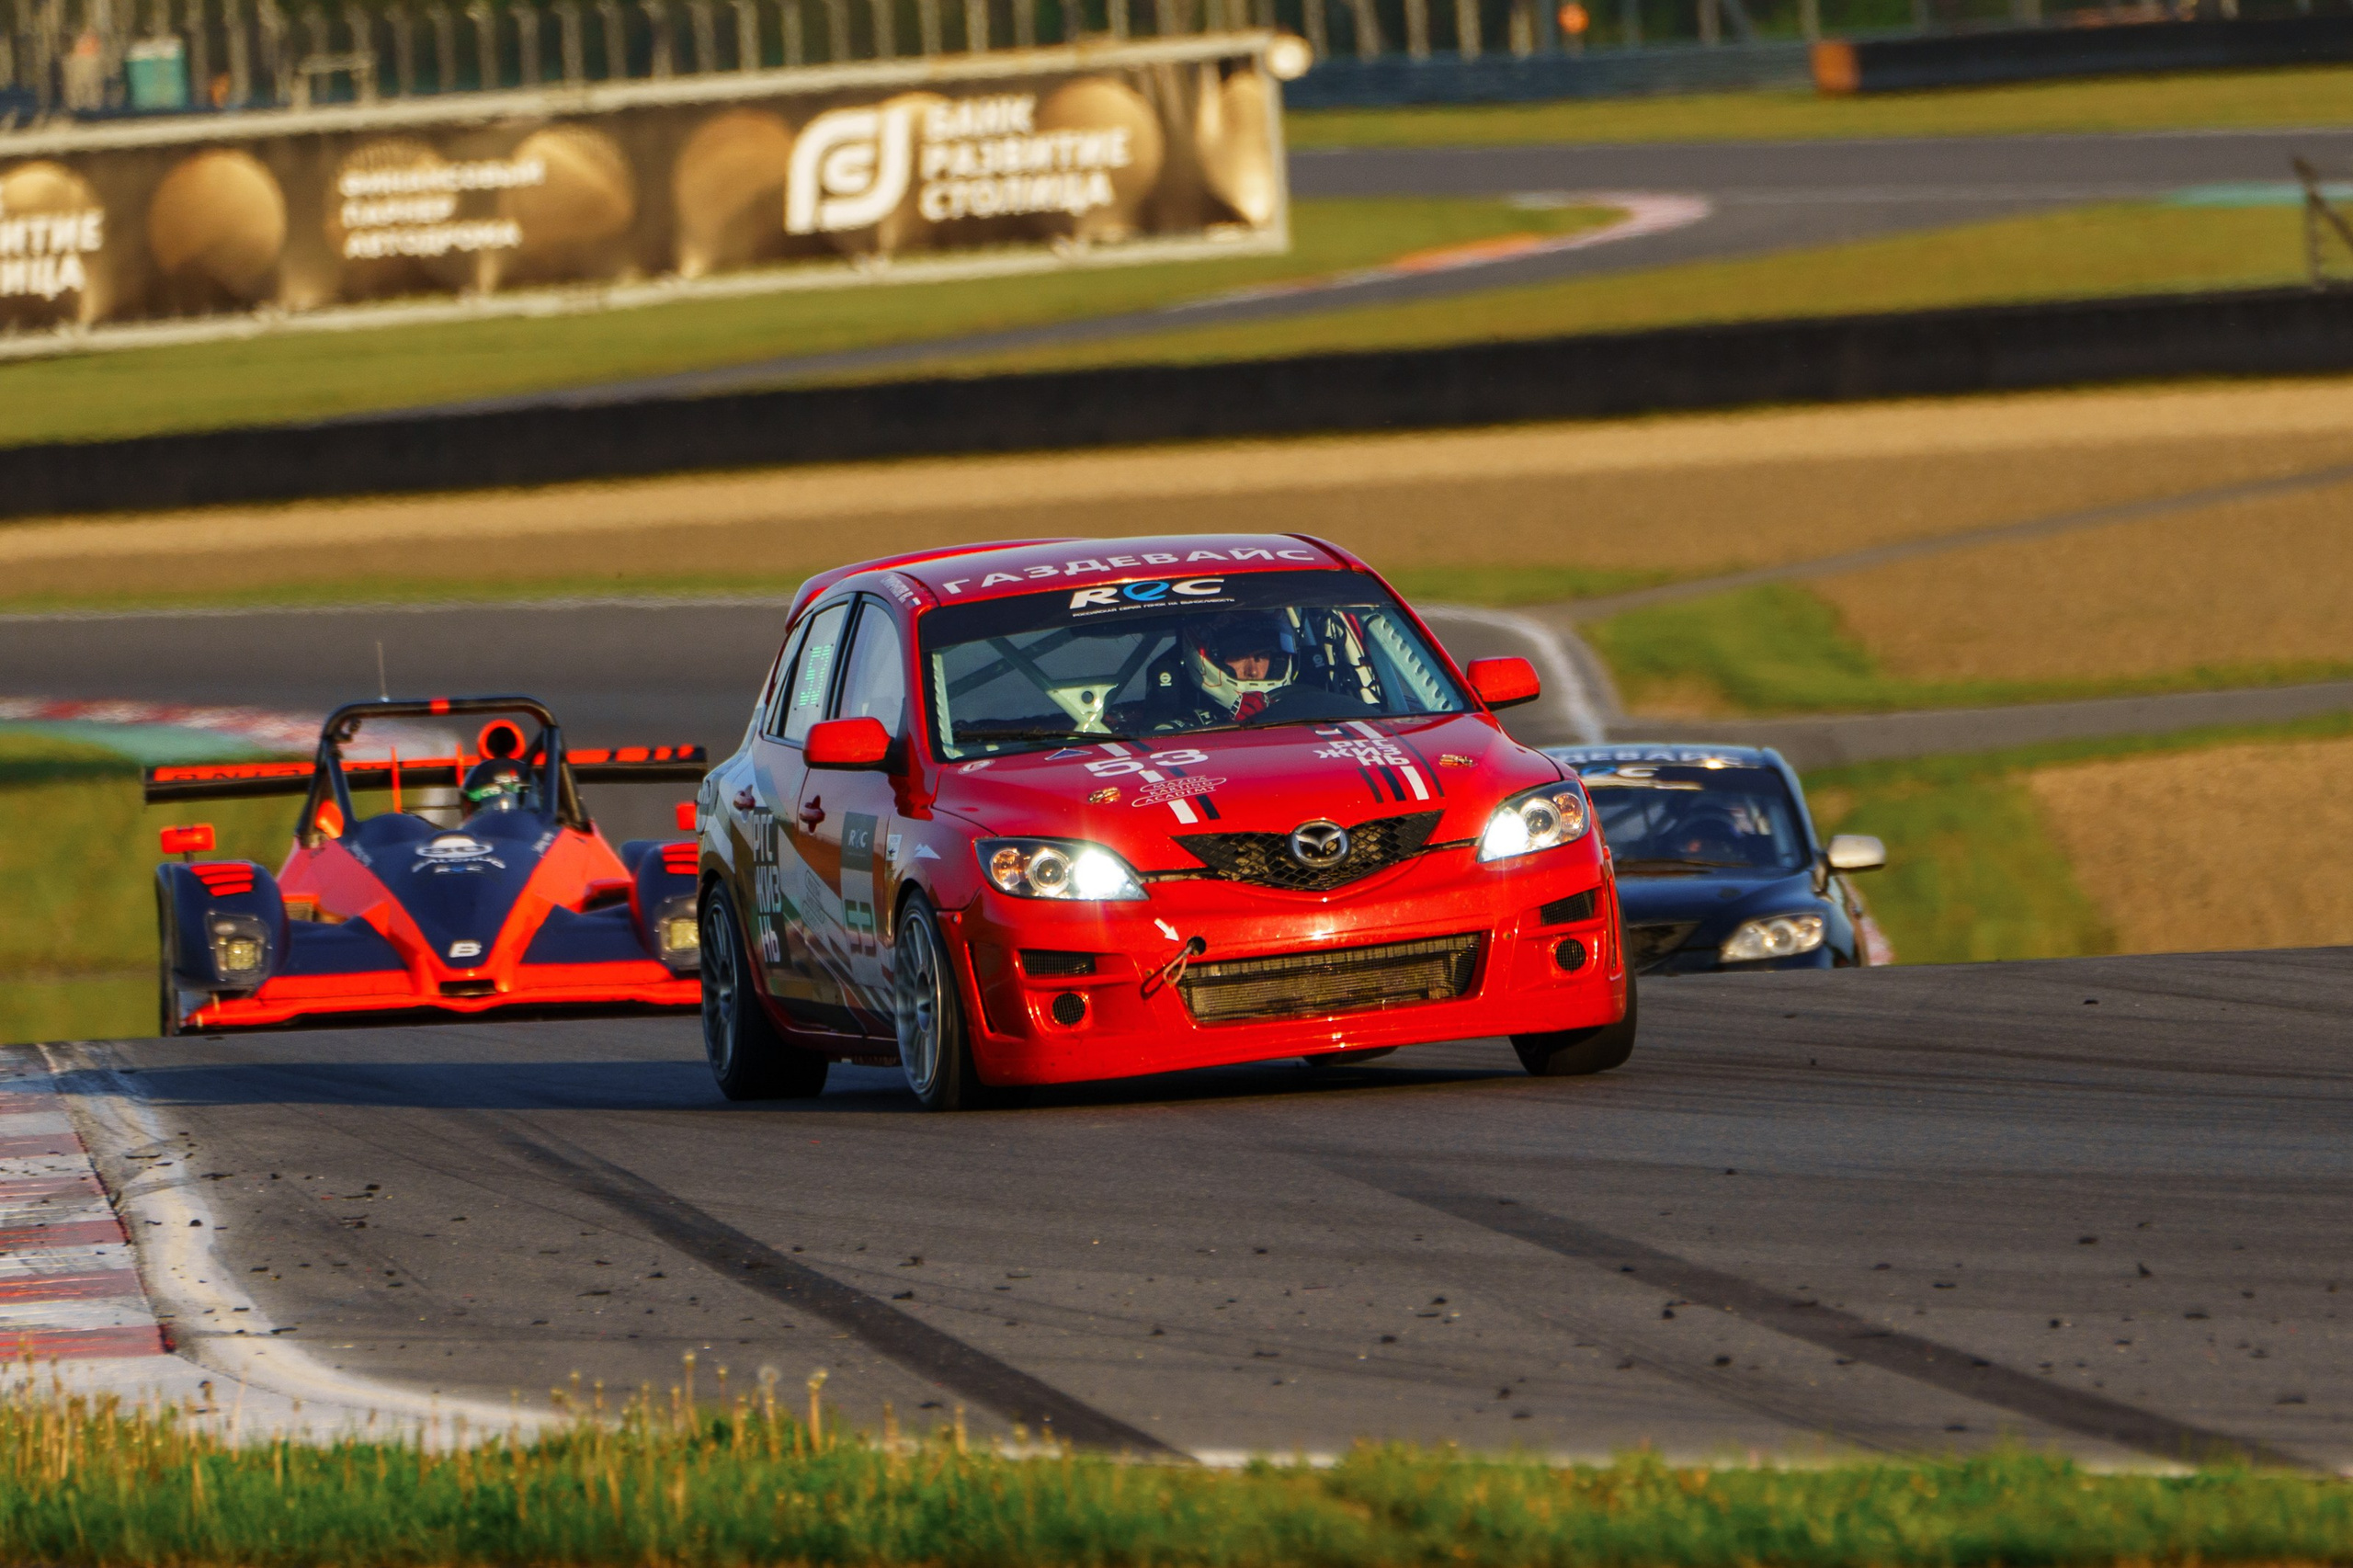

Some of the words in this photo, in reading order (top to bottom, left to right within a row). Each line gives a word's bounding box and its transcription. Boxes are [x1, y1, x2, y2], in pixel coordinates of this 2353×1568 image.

[924, 96, 1036, 141] БАНК
[922, 129, 1131, 182] РАЗВИТИЕ
[920, 174, 1116, 222] СТОЛИЦА
[942, 548, 1315, 595] ГАЗДЕВАЙС
[1084, 749, 1209, 778] 53
[1313, 746, 1402, 759] ЖИЗ
[1328, 739, 1394, 750] РГС
[1356, 756, 1411, 767] НЬ
[753, 813, 774, 862] РГС
